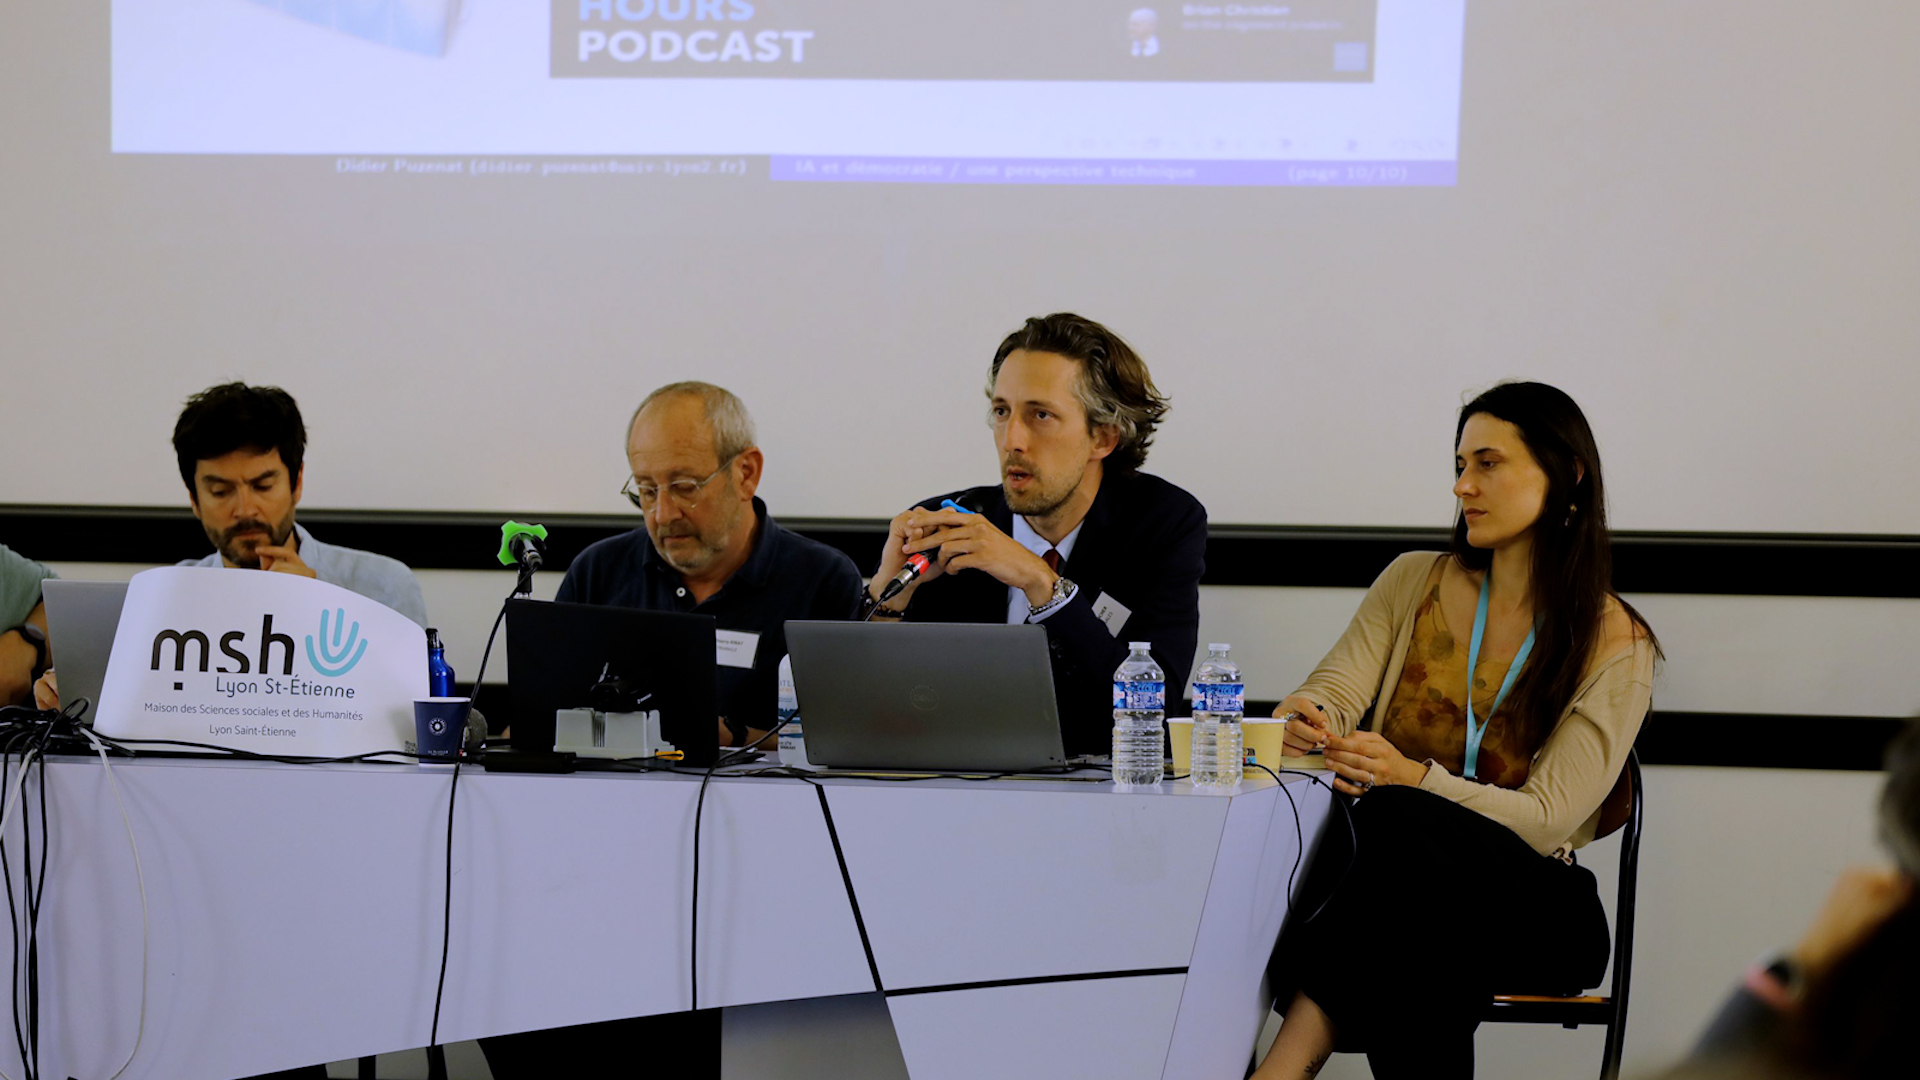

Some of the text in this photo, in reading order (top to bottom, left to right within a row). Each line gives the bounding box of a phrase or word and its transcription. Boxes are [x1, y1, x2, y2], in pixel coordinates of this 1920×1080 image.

[579, 0, 755, 21] HOURS
[578, 29, 814, 62] PODCAST
[336, 158, 387, 173] Didier
[393, 158, 462, 173] Puzenat
[795, 160, 1197, 181] IA et démocratie / une perspective technique
[1288, 165, 1408, 182] (page 10/10)
[150, 614, 295, 676] msh
[216, 674, 355, 698] Lyon St-Étienne
[144, 702, 364, 721] Maison des Sciences sociales et des Humanités
[209, 723, 297, 737] Lyon Saint-Étienne
